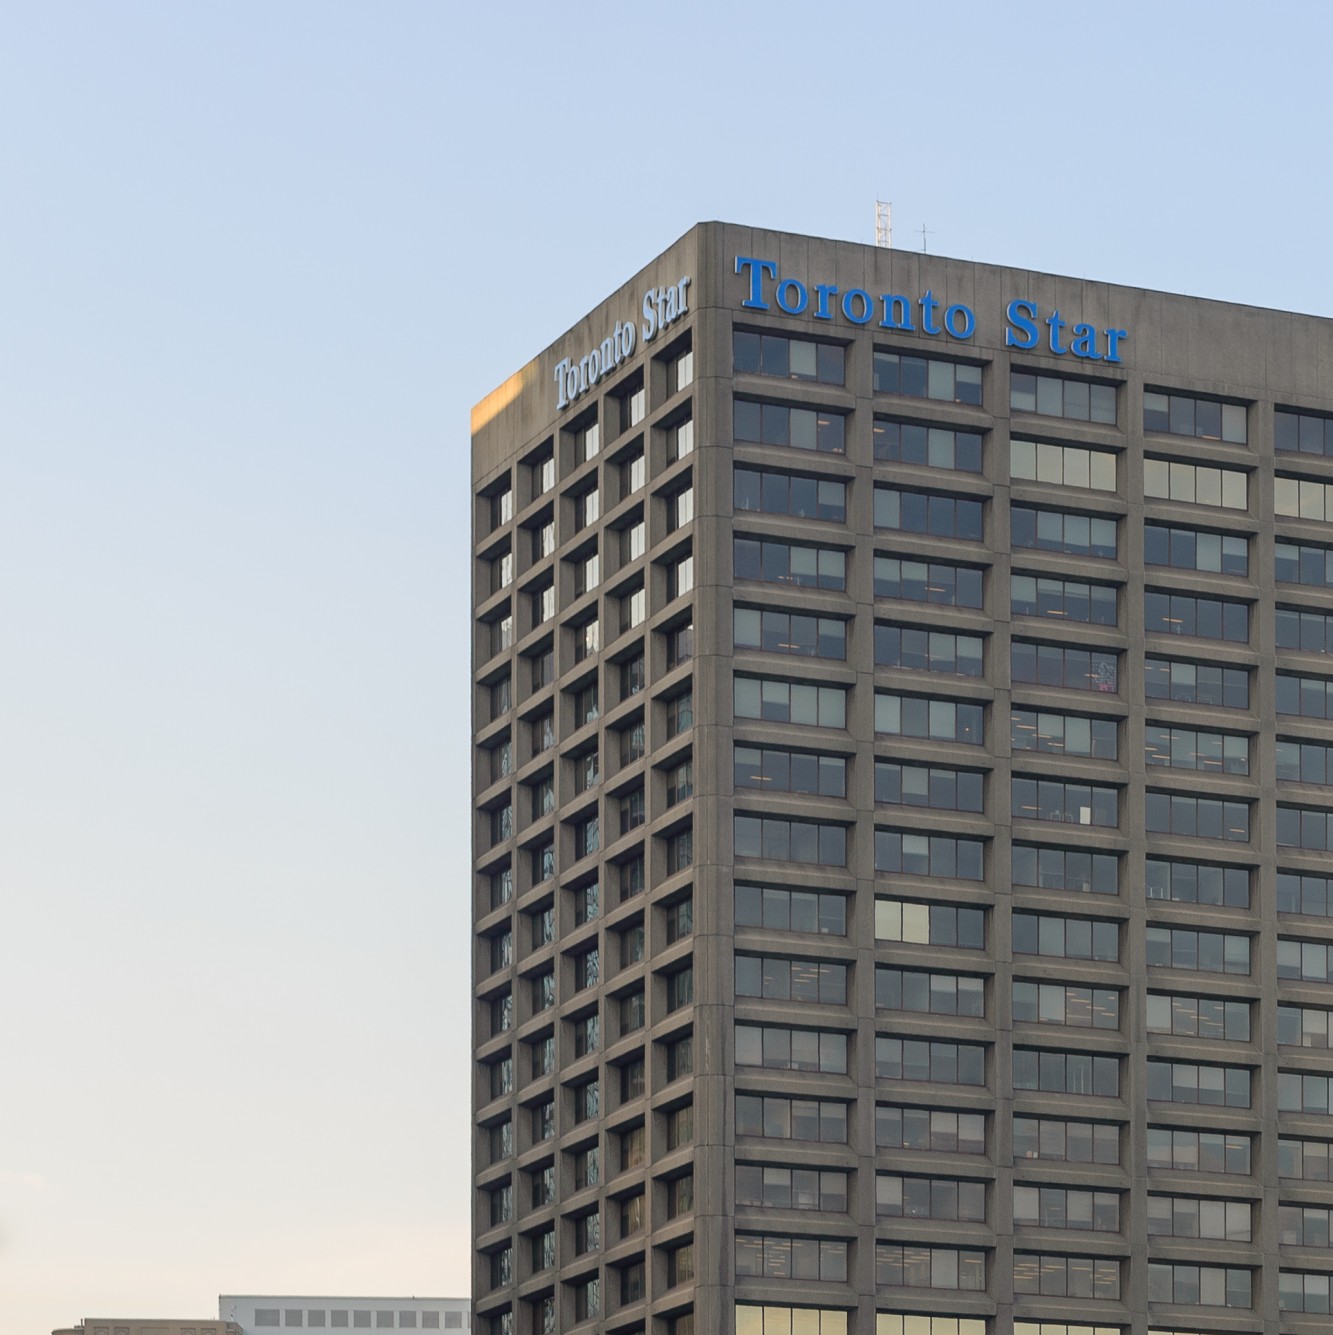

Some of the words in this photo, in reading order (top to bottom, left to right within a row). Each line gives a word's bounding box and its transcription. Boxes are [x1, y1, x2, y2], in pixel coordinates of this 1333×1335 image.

[554, 320, 636, 411] Toronto
[642, 276, 691, 342] Star
[734, 255, 976, 340] Toronto
[1004, 299, 1128, 363] Star
